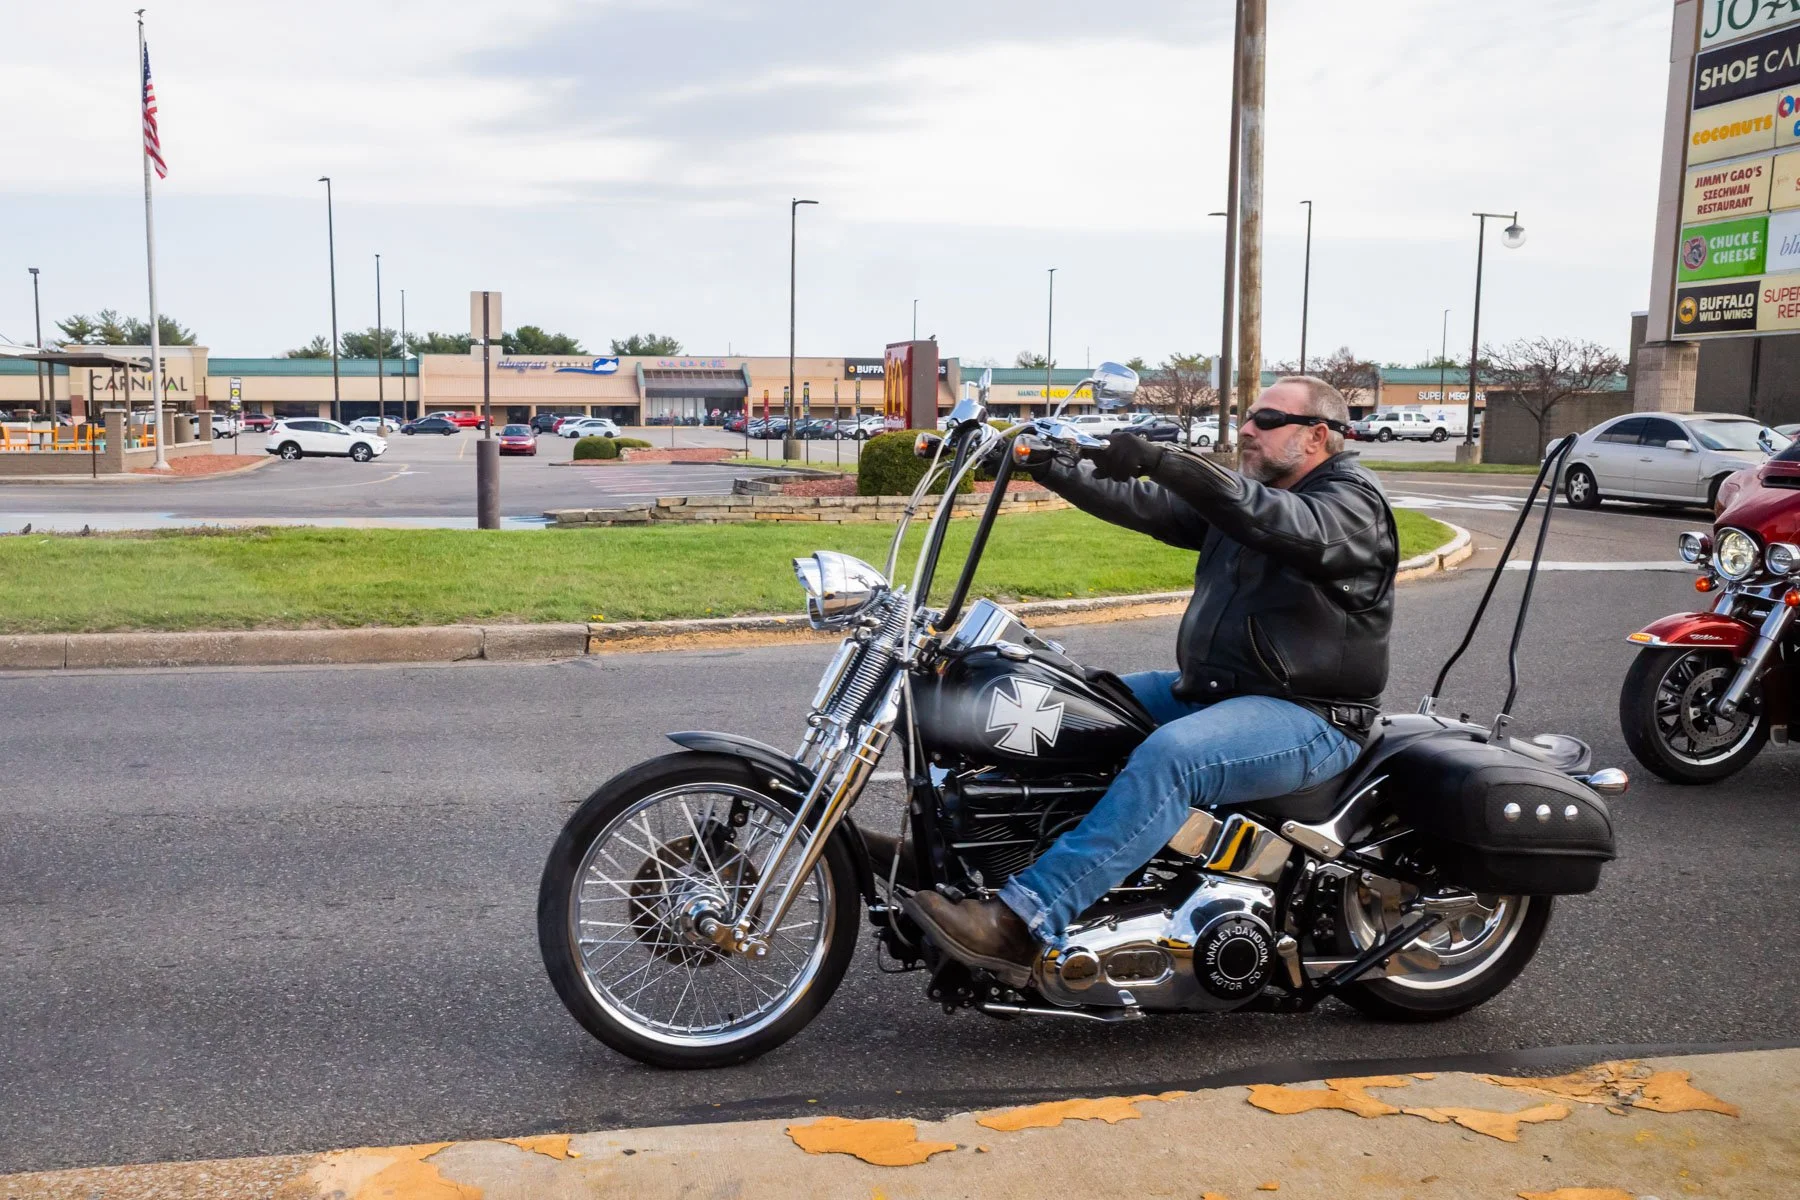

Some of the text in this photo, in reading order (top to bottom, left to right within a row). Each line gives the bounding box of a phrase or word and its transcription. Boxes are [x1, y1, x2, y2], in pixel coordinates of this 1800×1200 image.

[1699, 55, 1759, 91] SHOE
[1692, 114, 1773, 146] COCONUTS
[1695, 172, 1729, 188] JIMMY
[1730, 165, 1762, 182] GAO'S
[1703, 183, 1750, 201] SZECHWAN
[1697, 196, 1754, 215] RESTAURANT
[1709, 231, 1750, 250] CHUCK
[1712, 247, 1757, 265] CHEESE
[1699, 293, 1755, 311] BUFFALO
[1699, 308, 1753, 322] WILD WINGS
[1209, 971, 1243, 990] MOTOR
